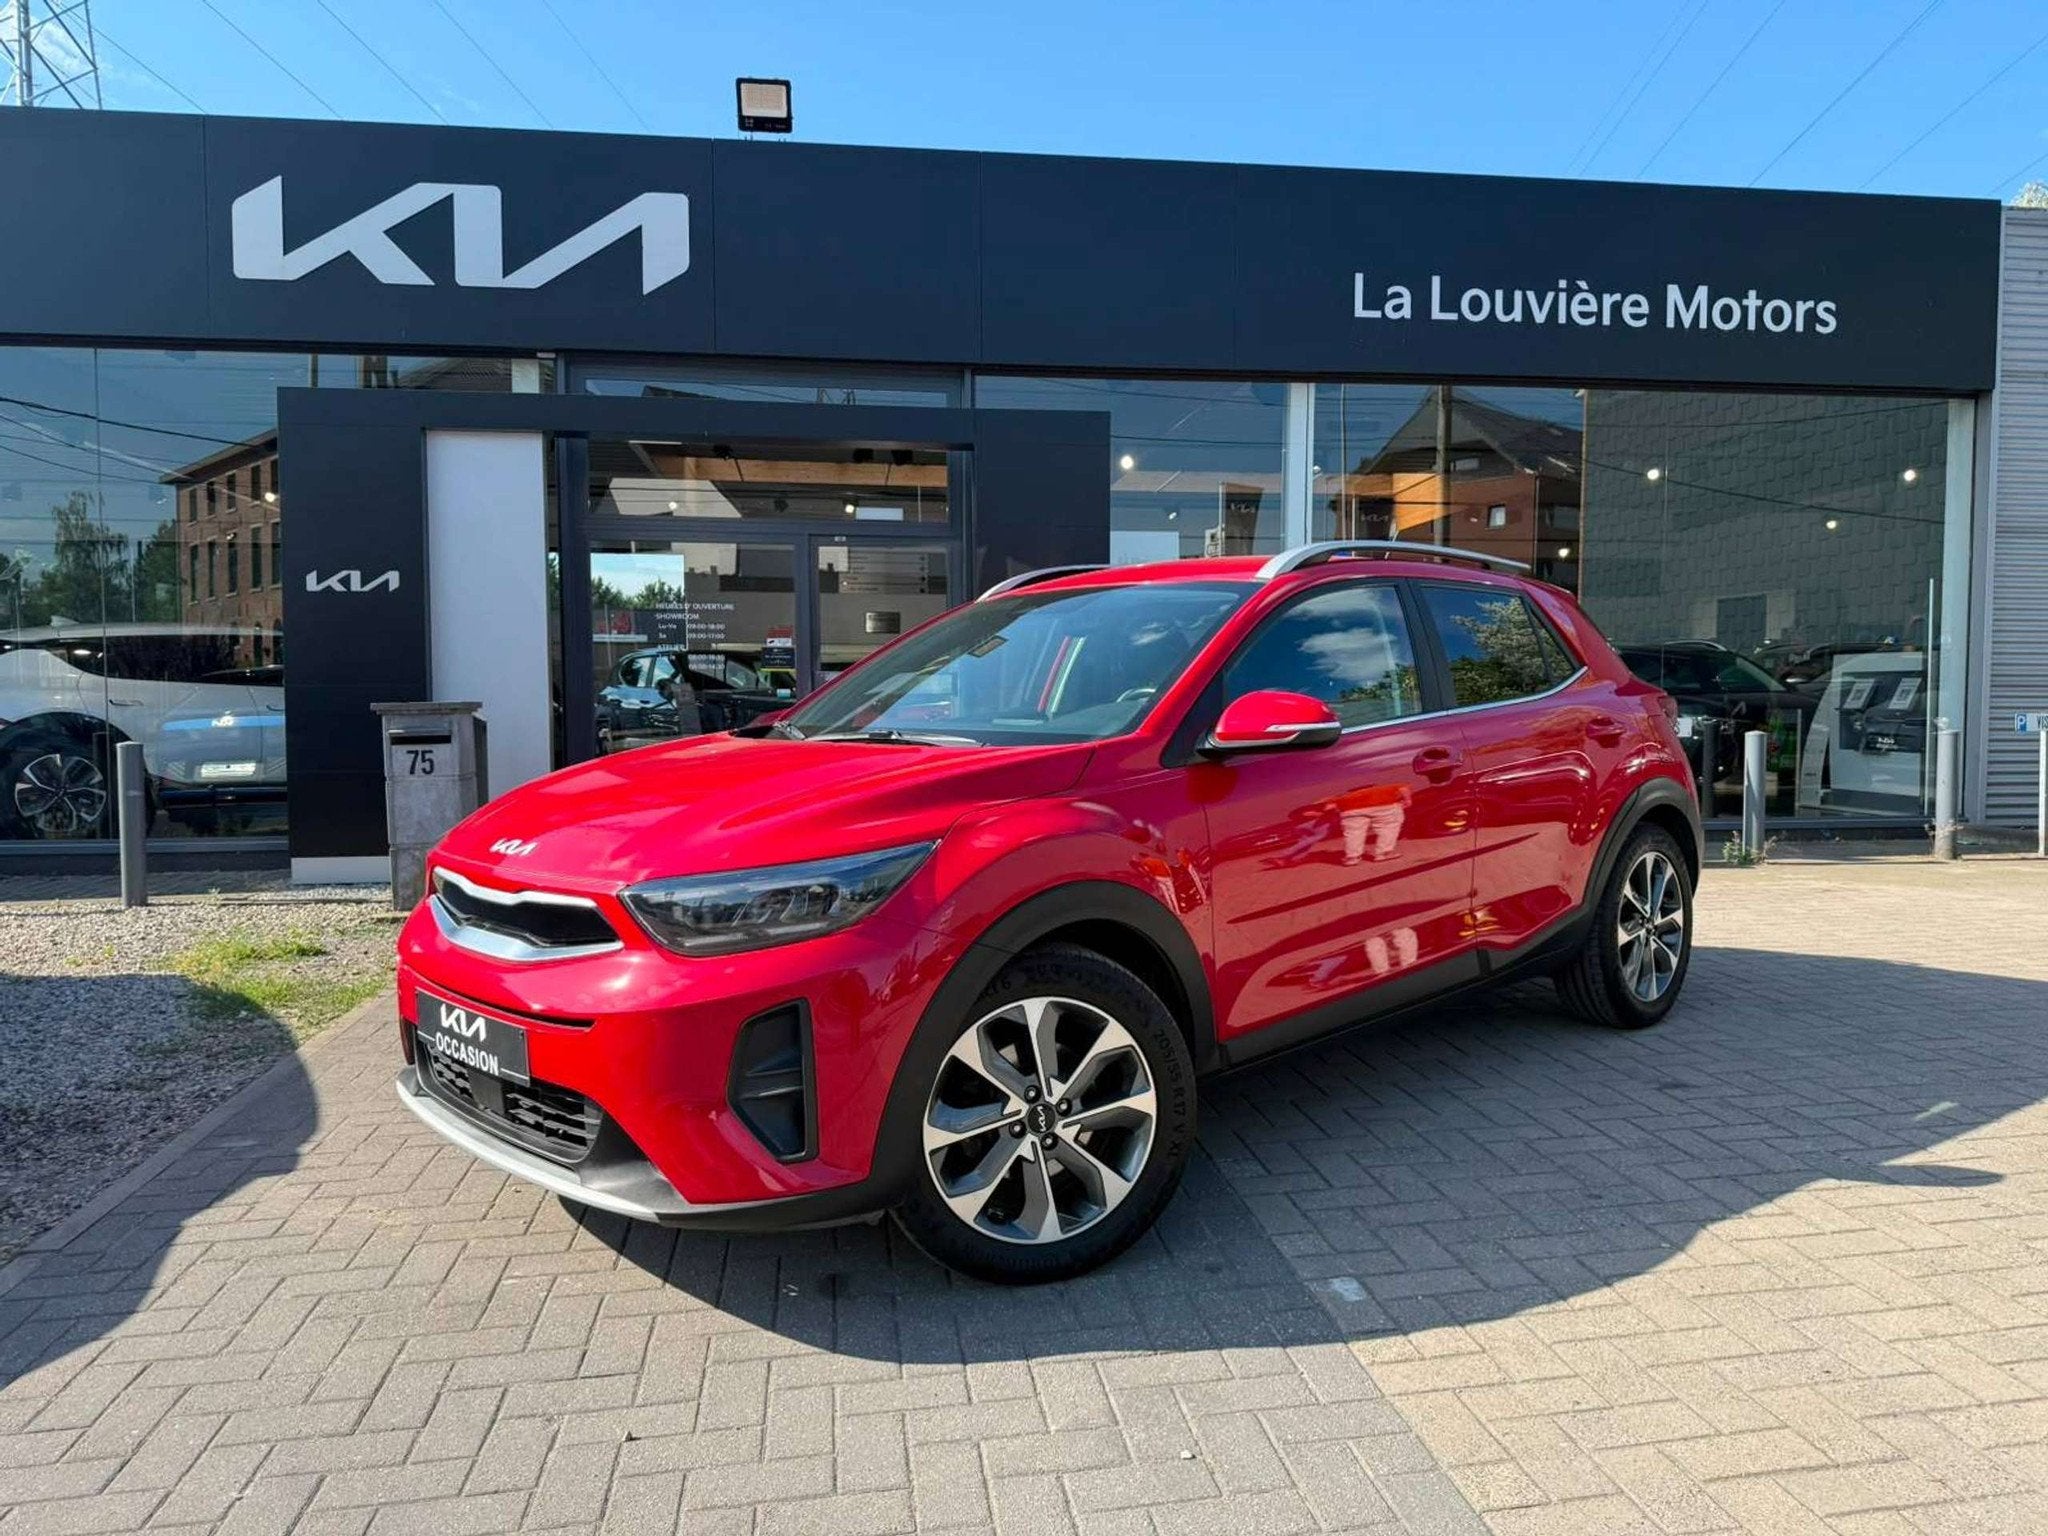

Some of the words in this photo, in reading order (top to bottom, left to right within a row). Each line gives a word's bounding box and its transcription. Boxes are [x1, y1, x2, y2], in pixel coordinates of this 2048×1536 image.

[232, 174, 690, 296] KIA
[1353, 272, 1412, 320] La
[1431, 275, 1649, 328] Louvière
[1665, 284, 1838, 335] Motors
[305, 569, 400, 592] KIA
[655, 612, 700, 621] SHOWROOM
[692, 602, 735, 611] OUVERTURE
[406, 749, 435, 775] 75
[489, 838, 538, 857] KIA
[440, 1003, 487, 1042] KIA
[435, 1031, 499, 1077] OCCASION
